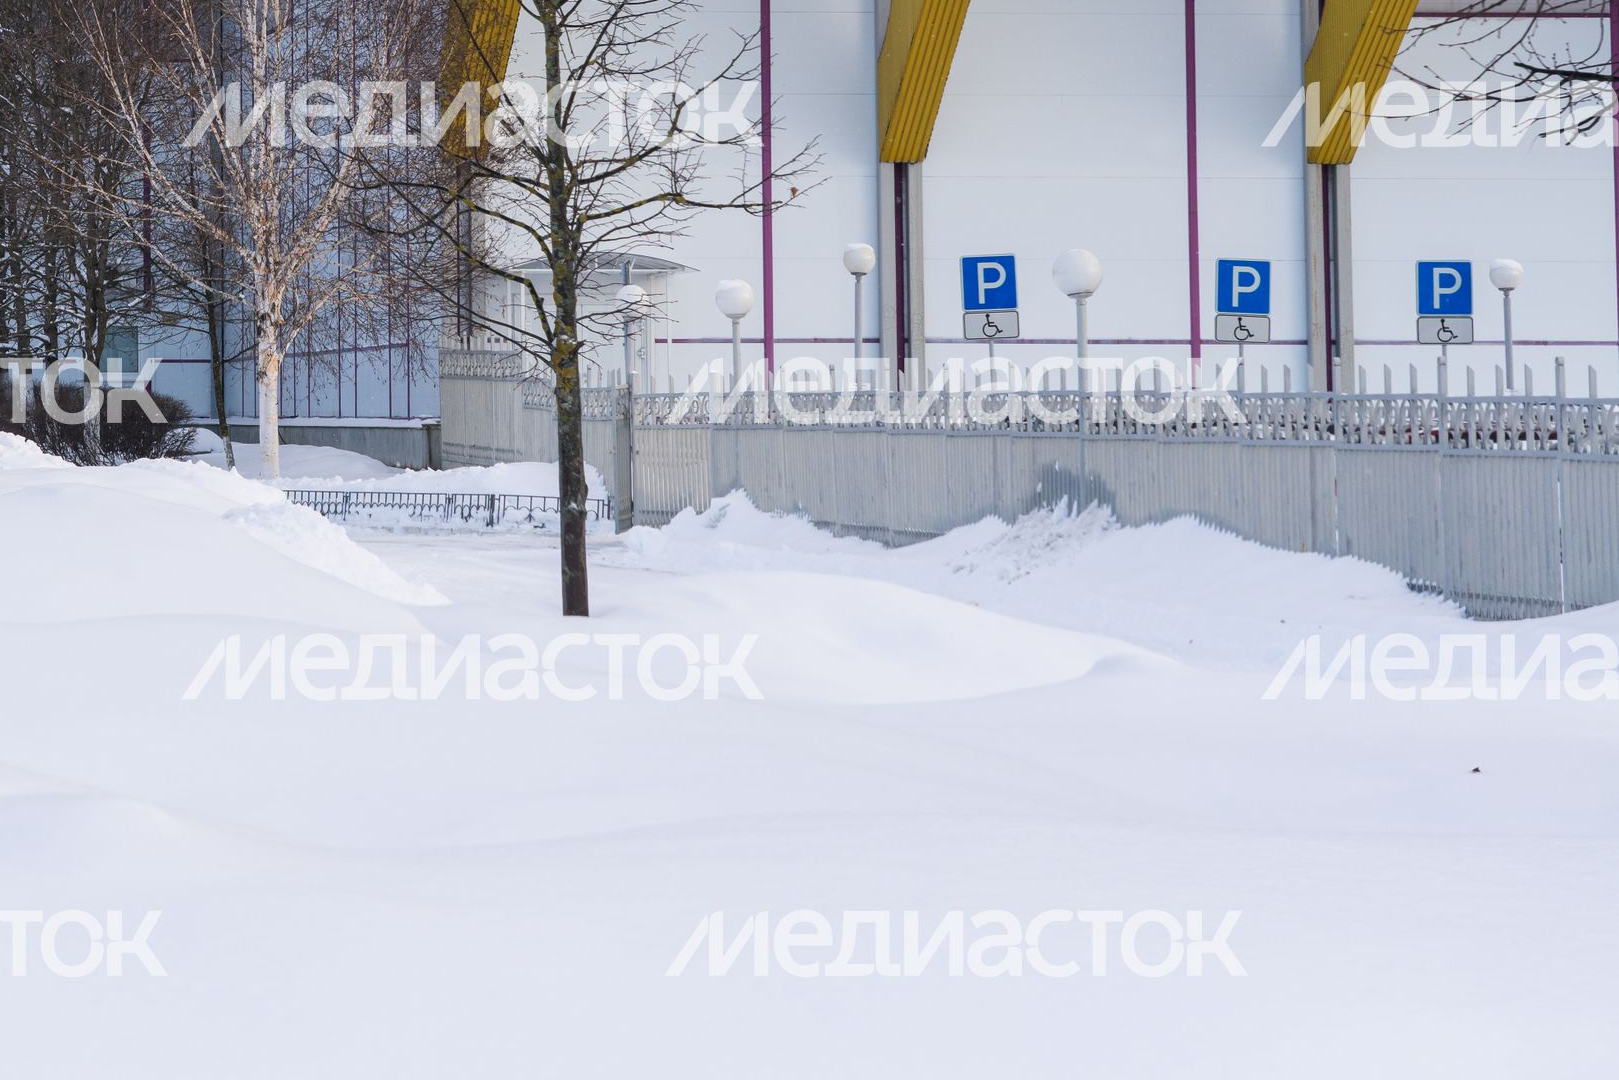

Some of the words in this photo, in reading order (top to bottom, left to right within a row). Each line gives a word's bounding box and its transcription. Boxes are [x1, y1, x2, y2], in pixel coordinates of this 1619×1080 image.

[977, 261, 1007, 305] P
[1232, 265, 1261, 308] P
[1432, 267, 1462, 310] P
